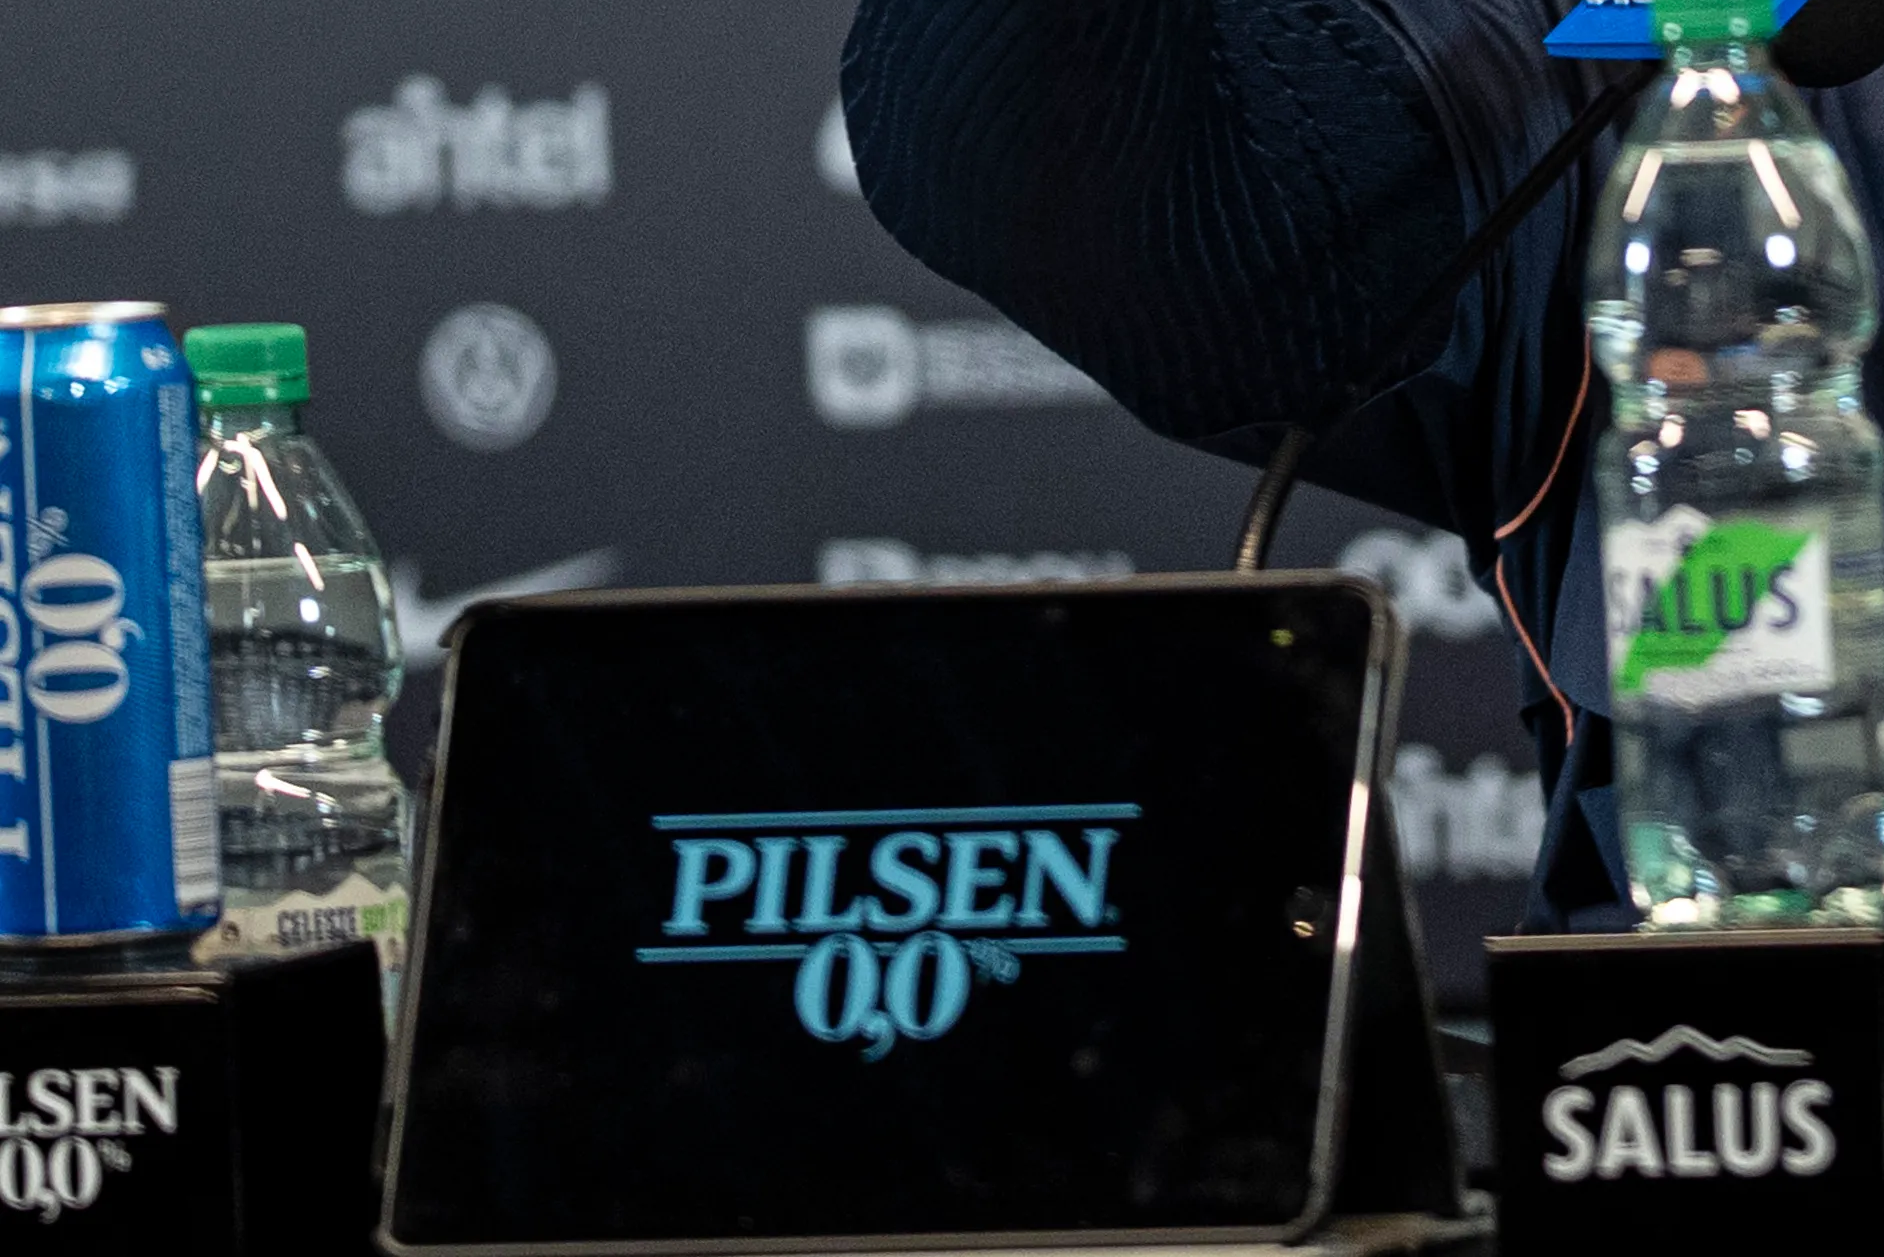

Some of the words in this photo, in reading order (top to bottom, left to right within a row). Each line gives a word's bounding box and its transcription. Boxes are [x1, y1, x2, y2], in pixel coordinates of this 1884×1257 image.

[345, 75, 611, 211] antel
[1608, 560, 1800, 634] SALUS
[661, 827, 1119, 936] PILSEN
[1542, 1080, 1836, 1182] SALUS
